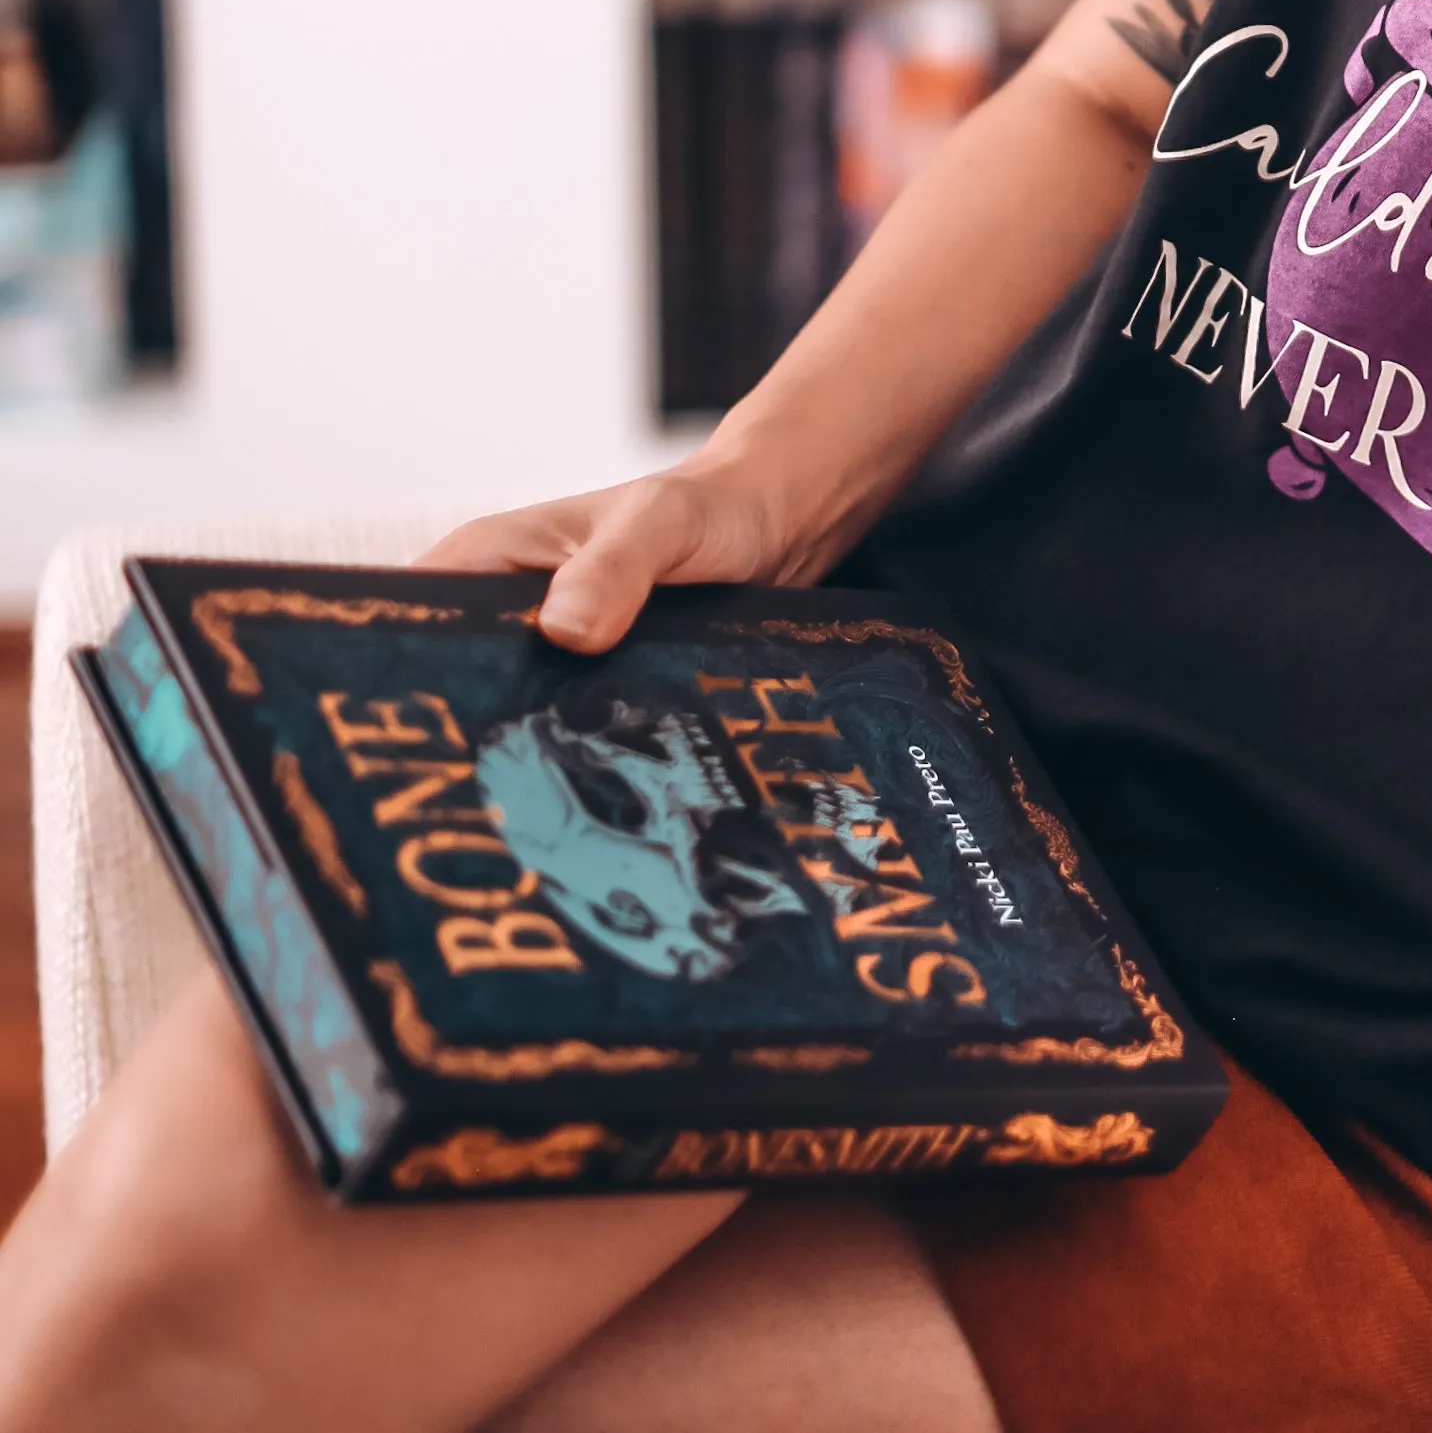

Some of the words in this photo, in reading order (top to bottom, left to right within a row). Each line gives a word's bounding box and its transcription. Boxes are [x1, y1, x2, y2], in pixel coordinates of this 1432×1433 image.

[1121, 238, 1432, 512] NEVER
[317, 690, 584, 977] BONE
[694, 671, 987, 1006] SMITH
[907, 744, 955, 808] Preto
[946, 812, 984, 857] Pau
[967, 860, 1024, 927] Nicki
